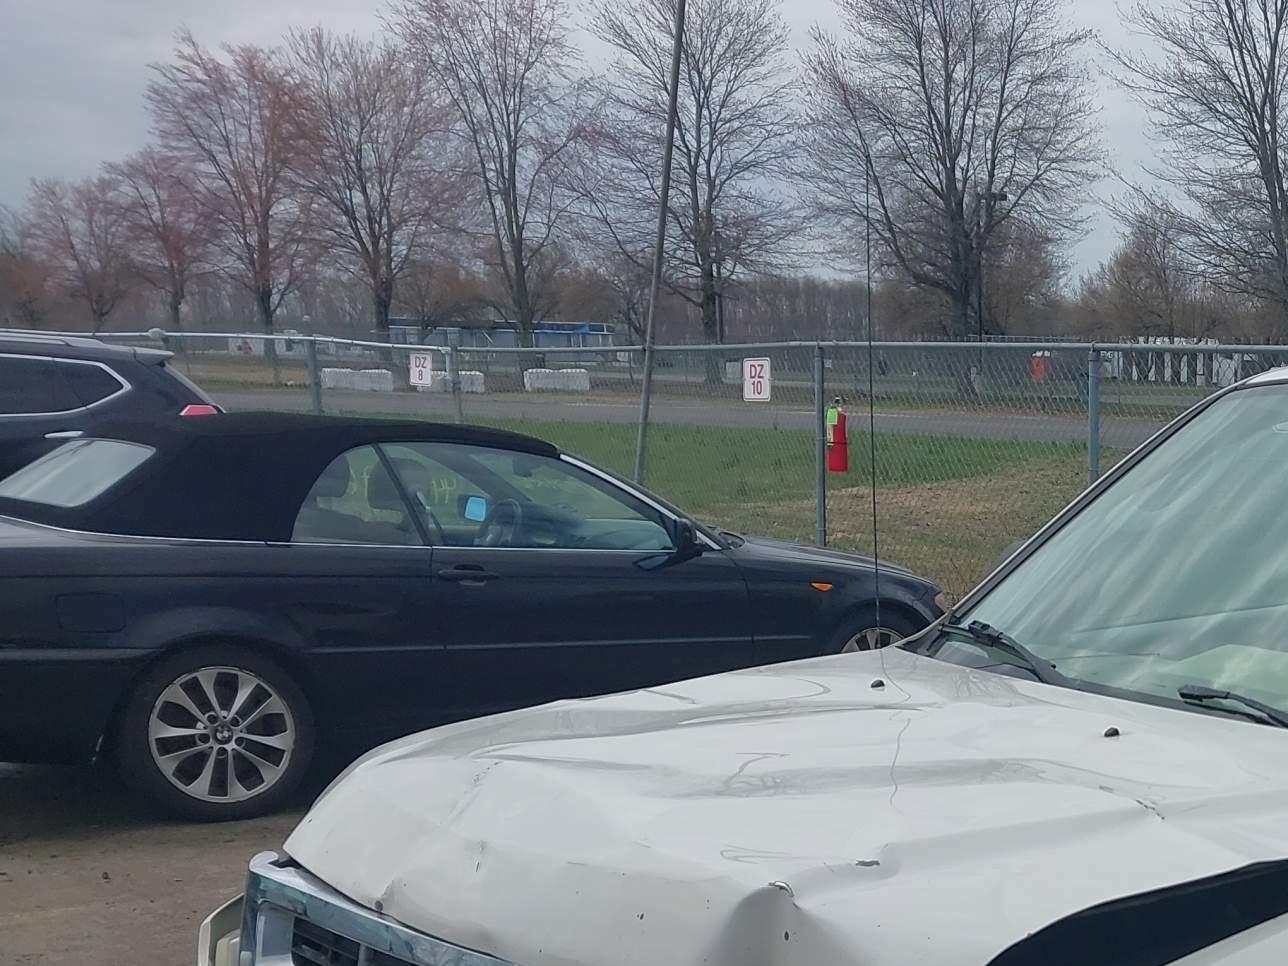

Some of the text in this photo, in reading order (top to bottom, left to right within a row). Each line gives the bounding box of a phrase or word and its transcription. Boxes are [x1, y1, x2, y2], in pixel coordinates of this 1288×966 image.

[415, 356, 427, 369] DZ
[418, 370, 423, 381] 8
[750, 364, 764, 379] DZ
[751, 380, 762, 395] 10
